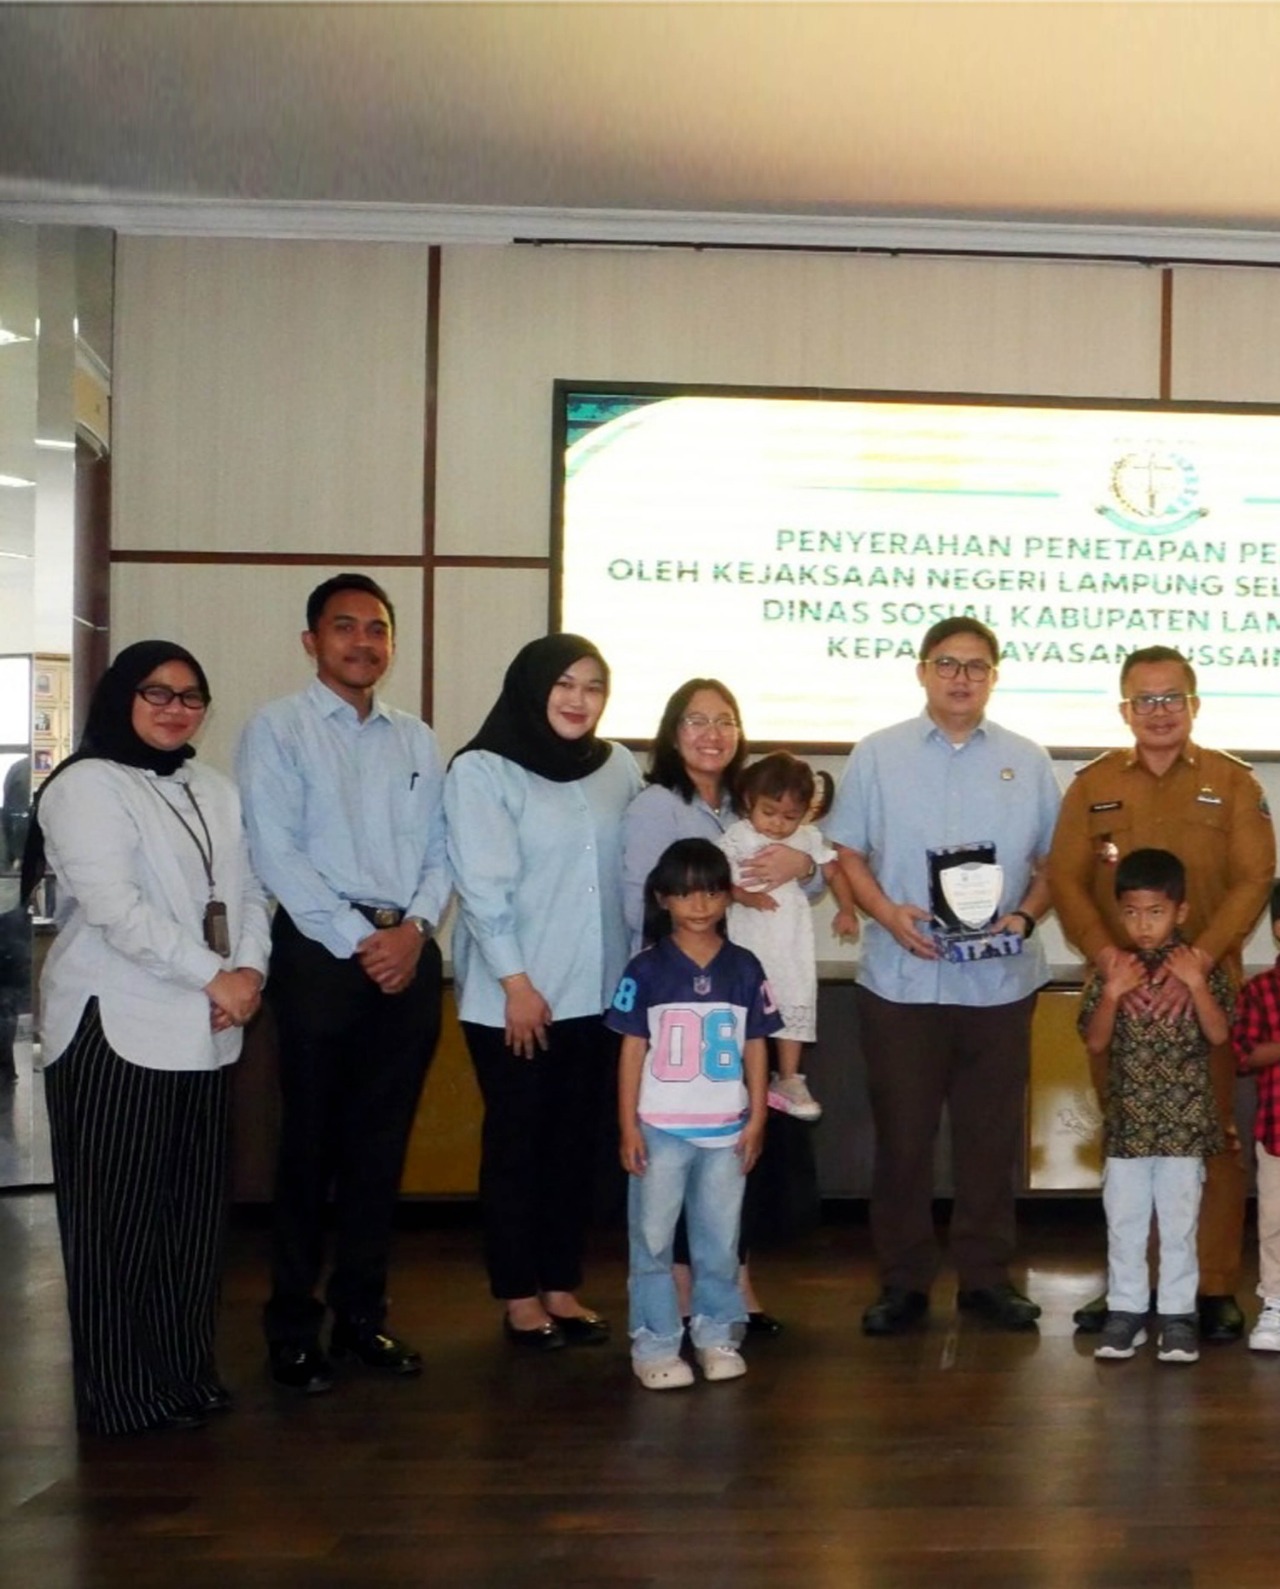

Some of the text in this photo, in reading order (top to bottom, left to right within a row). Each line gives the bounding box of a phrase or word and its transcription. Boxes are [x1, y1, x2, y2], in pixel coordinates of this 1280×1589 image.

[776, 529, 1011, 557] PENYERAHAN
[1024, 536, 1226, 563] PENETAPAN
[608, 558, 699, 582] OLEH
[712, 561, 914, 587] KEJAKSAAN
[927, 567, 1045, 592] NEGERI
[1058, 571, 1223, 597] LAMPUNG
[763, 599, 869, 623] DINAS
[881, 602, 999, 626] SOSIAL
[1011, 605, 1209, 631] KABUPATEN
[827, 636, 917, 659] KEPA
[1000, 641, 1138, 664] AYASAN
[613, 977, 637, 1013] 8
[651, 1008, 742, 1082] 08
